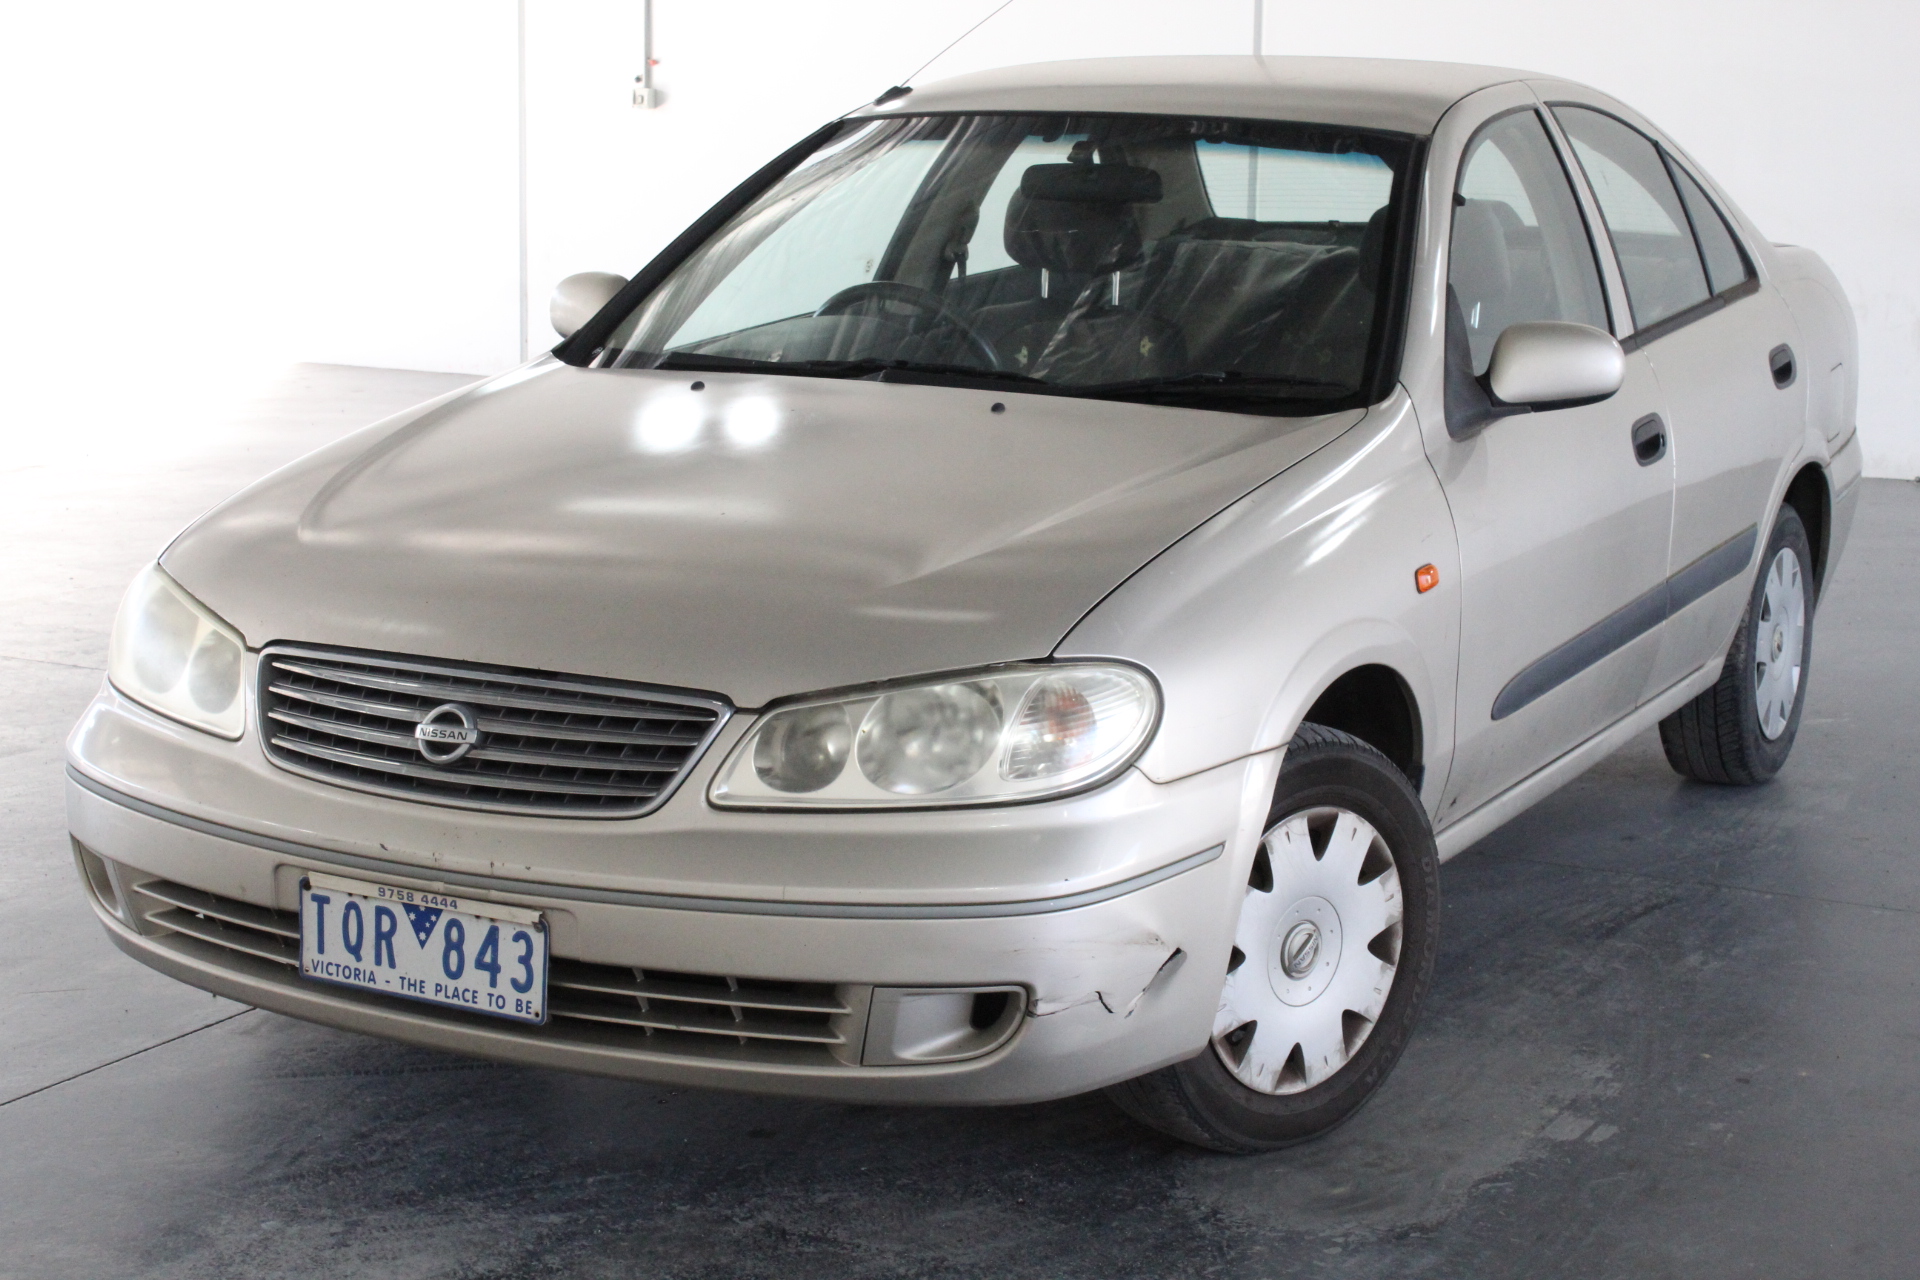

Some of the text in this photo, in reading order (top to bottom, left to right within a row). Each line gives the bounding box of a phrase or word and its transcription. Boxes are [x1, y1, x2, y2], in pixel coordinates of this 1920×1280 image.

[419, 727, 468, 741] NISSAN
[378, 887, 458, 910] 9758 4444
[311, 893, 534, 993] TQR 843
[311, 959, 377, 985] VICTORIA
[399, 976, 426, 994] THE
[435, 983, 478, 1005] PLACE
[487, 993, 506, 1010] TO
[515, 1001, 532, 1015] BE
